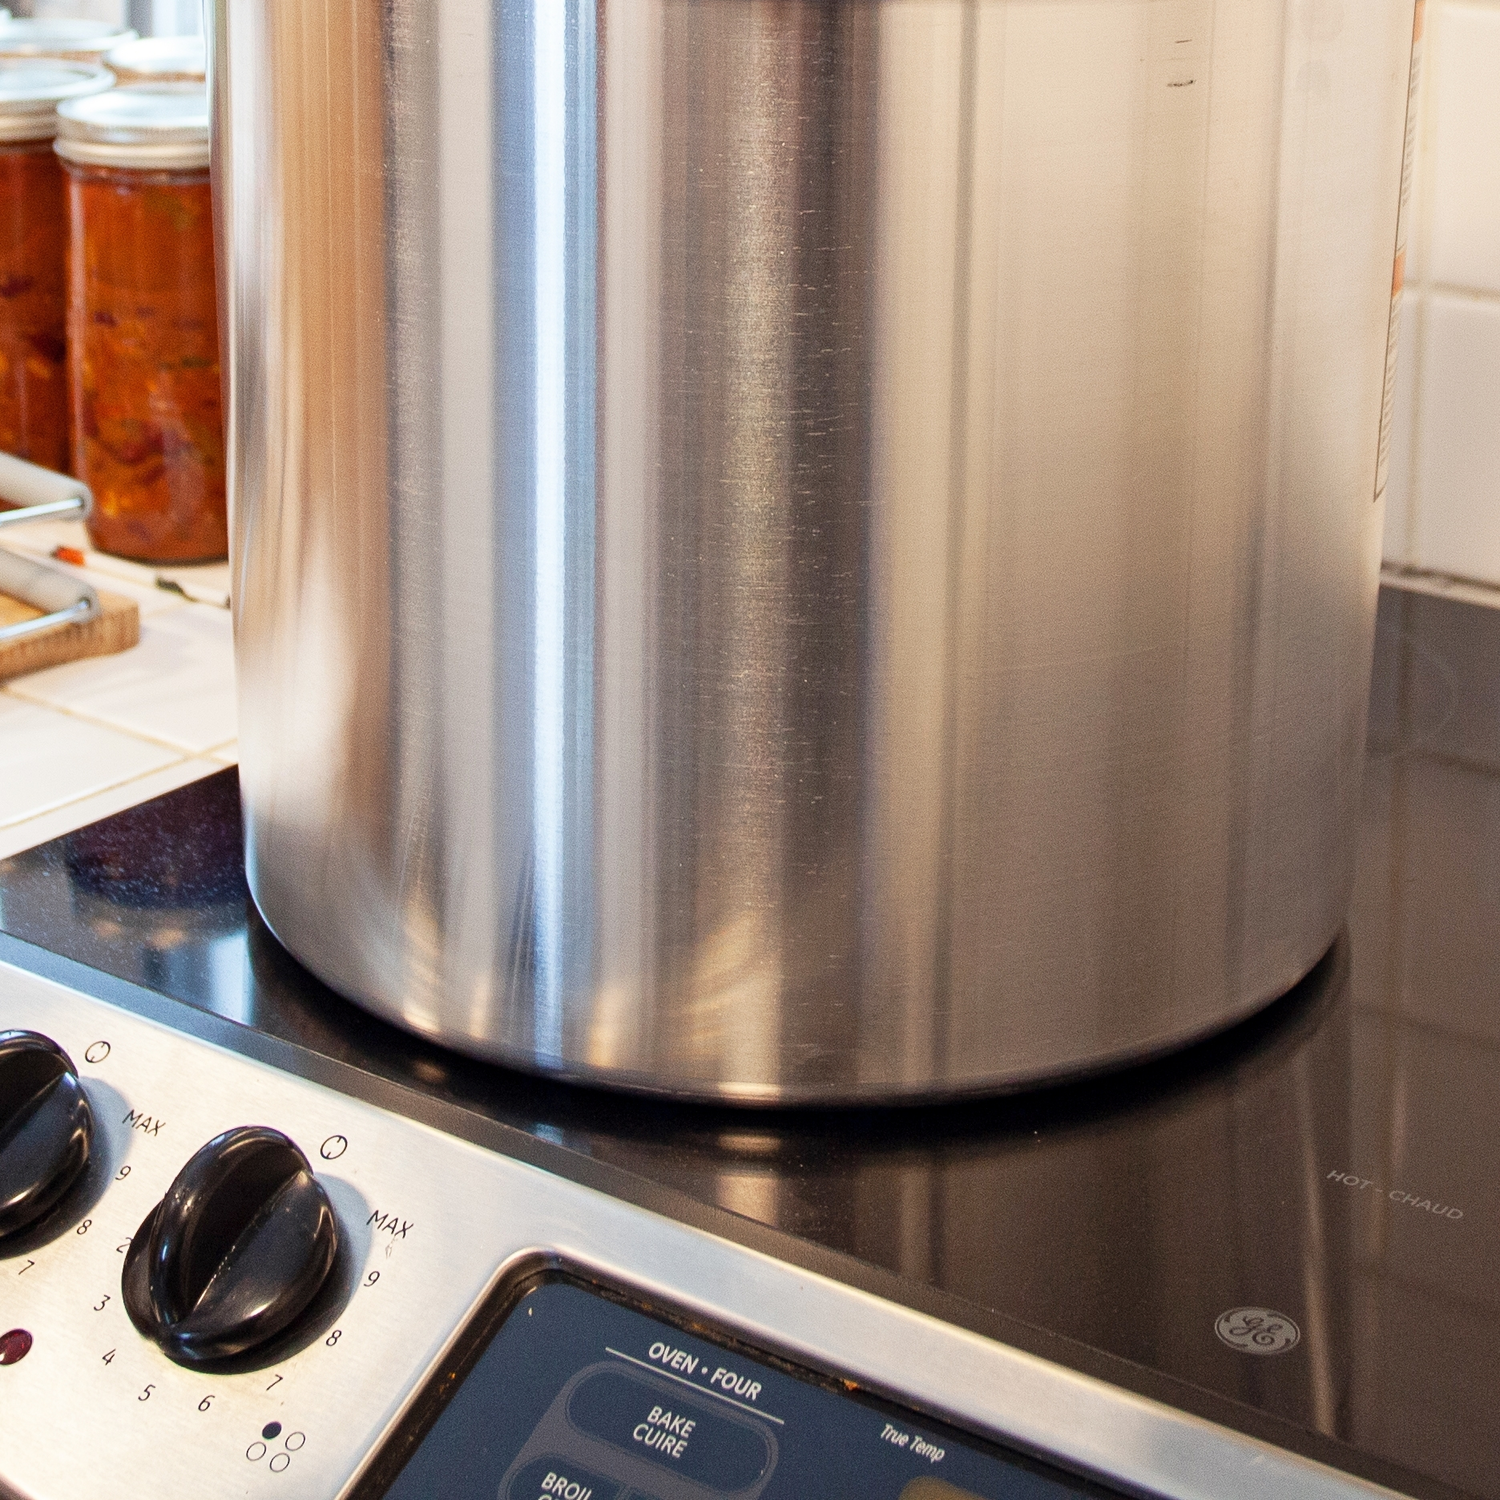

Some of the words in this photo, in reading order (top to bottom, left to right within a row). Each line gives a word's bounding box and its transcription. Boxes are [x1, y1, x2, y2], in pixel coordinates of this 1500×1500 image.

[122, 1109, 166, 1137] MAX
[116, 1165, 132, 1181] 9
[1326, 1170, 1374, 1191] HOT
[1388, 1188, 1464, 1220] CHAUD
[76, 1219, 92, 1235] 8
[366, 1210, 414, 1239] MAX
[17, 1259, 35, 1276] 7
[364, 1271, 381, 1287] 9
[93, 1295, 111, 1311] 3
[326, 1330, 342, 1346] 8
[101, 1349, 116, 1365] 4
[648, 1342, 700, 1374] OVEN
[710, 1367, 762, 1401] FOUR
[265, 1374, 283, 1391] 7
[138, 1384, 155, 1401] 5
[198, 1395, 215, 1412] 6
[647, 1405, 696, 1438] BAKE
[632, 1423, 688, 1458] CUIRE
[880, 1423, 909, 1446] True
[909, 1435, 945, 1464] Temp
